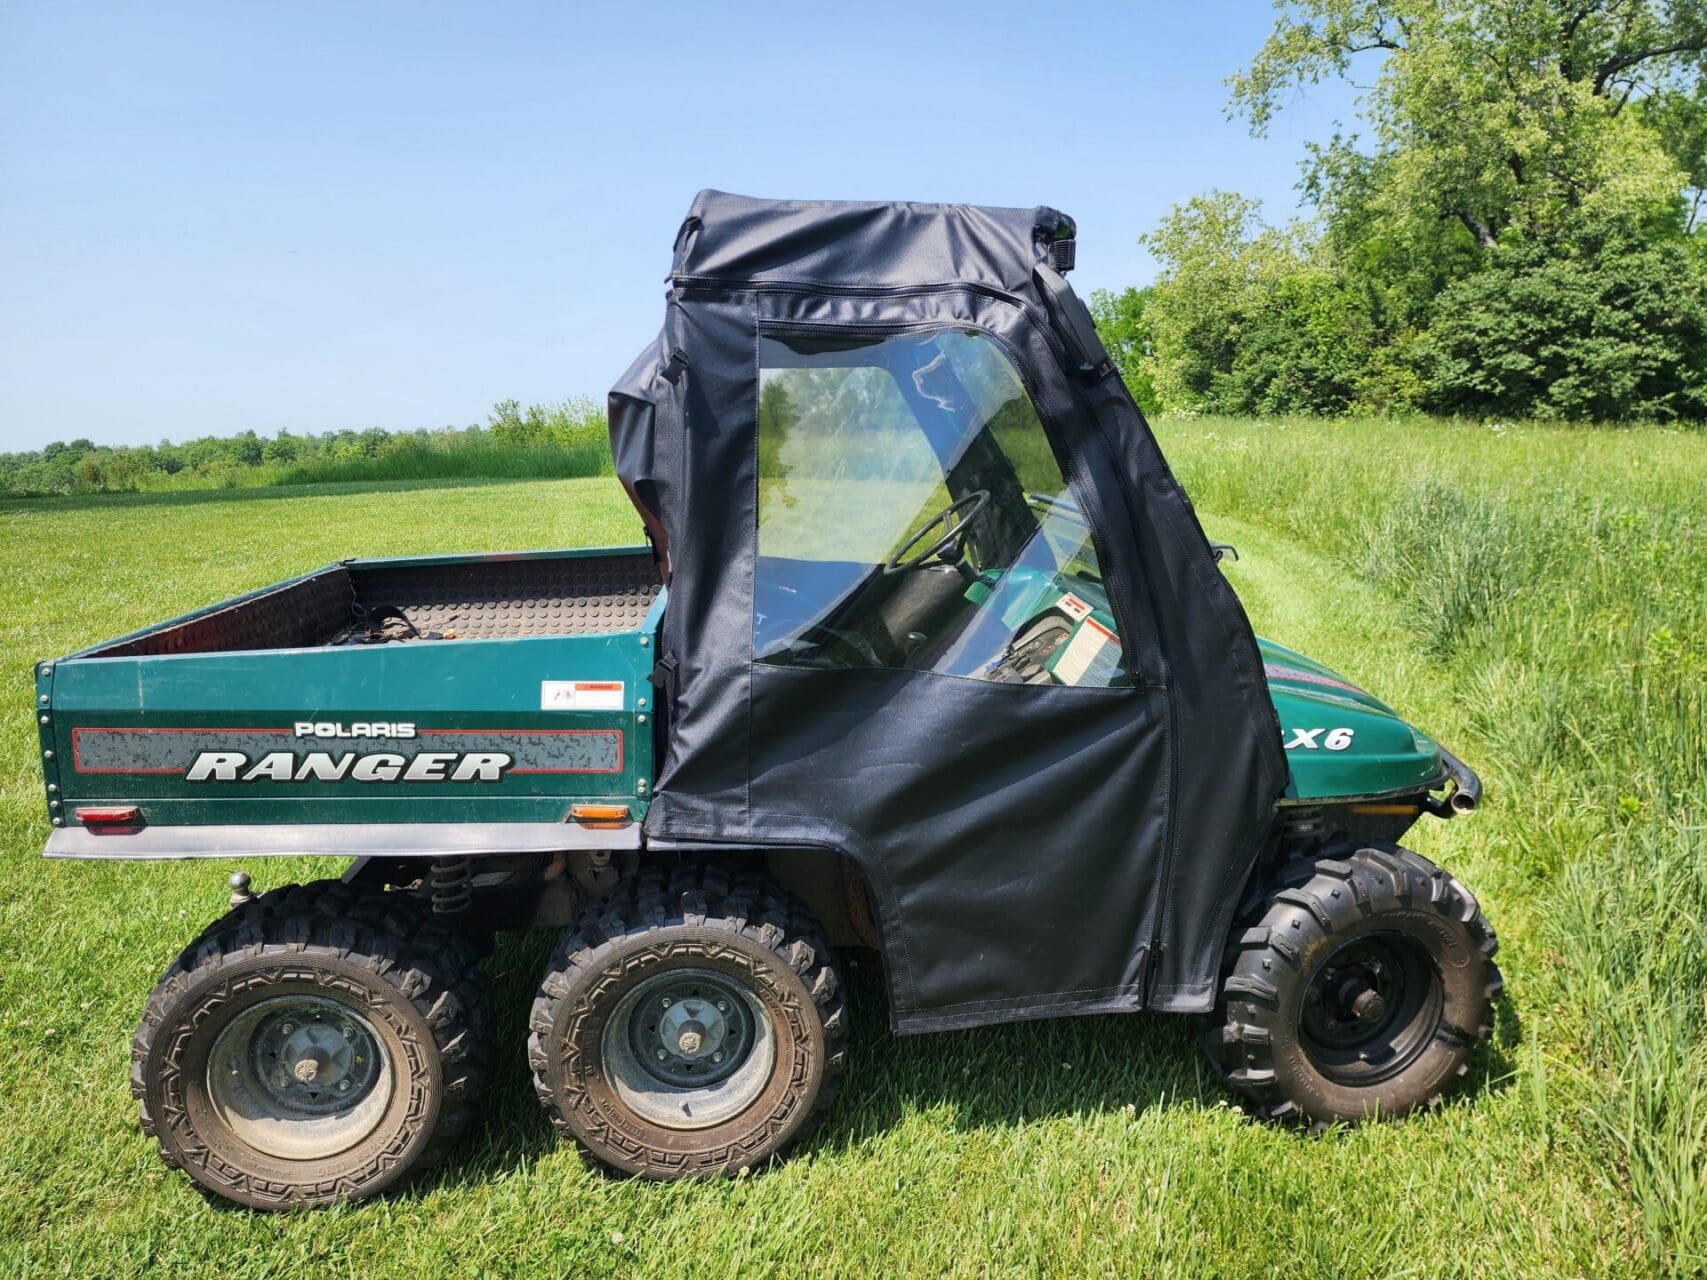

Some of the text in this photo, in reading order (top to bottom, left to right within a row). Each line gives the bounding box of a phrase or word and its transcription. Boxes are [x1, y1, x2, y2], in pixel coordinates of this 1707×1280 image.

[294, 721, 417, 739] POLARIS
[1281, 727, 1355, 751] X6
[185, 752, 512, 781] RANGER
